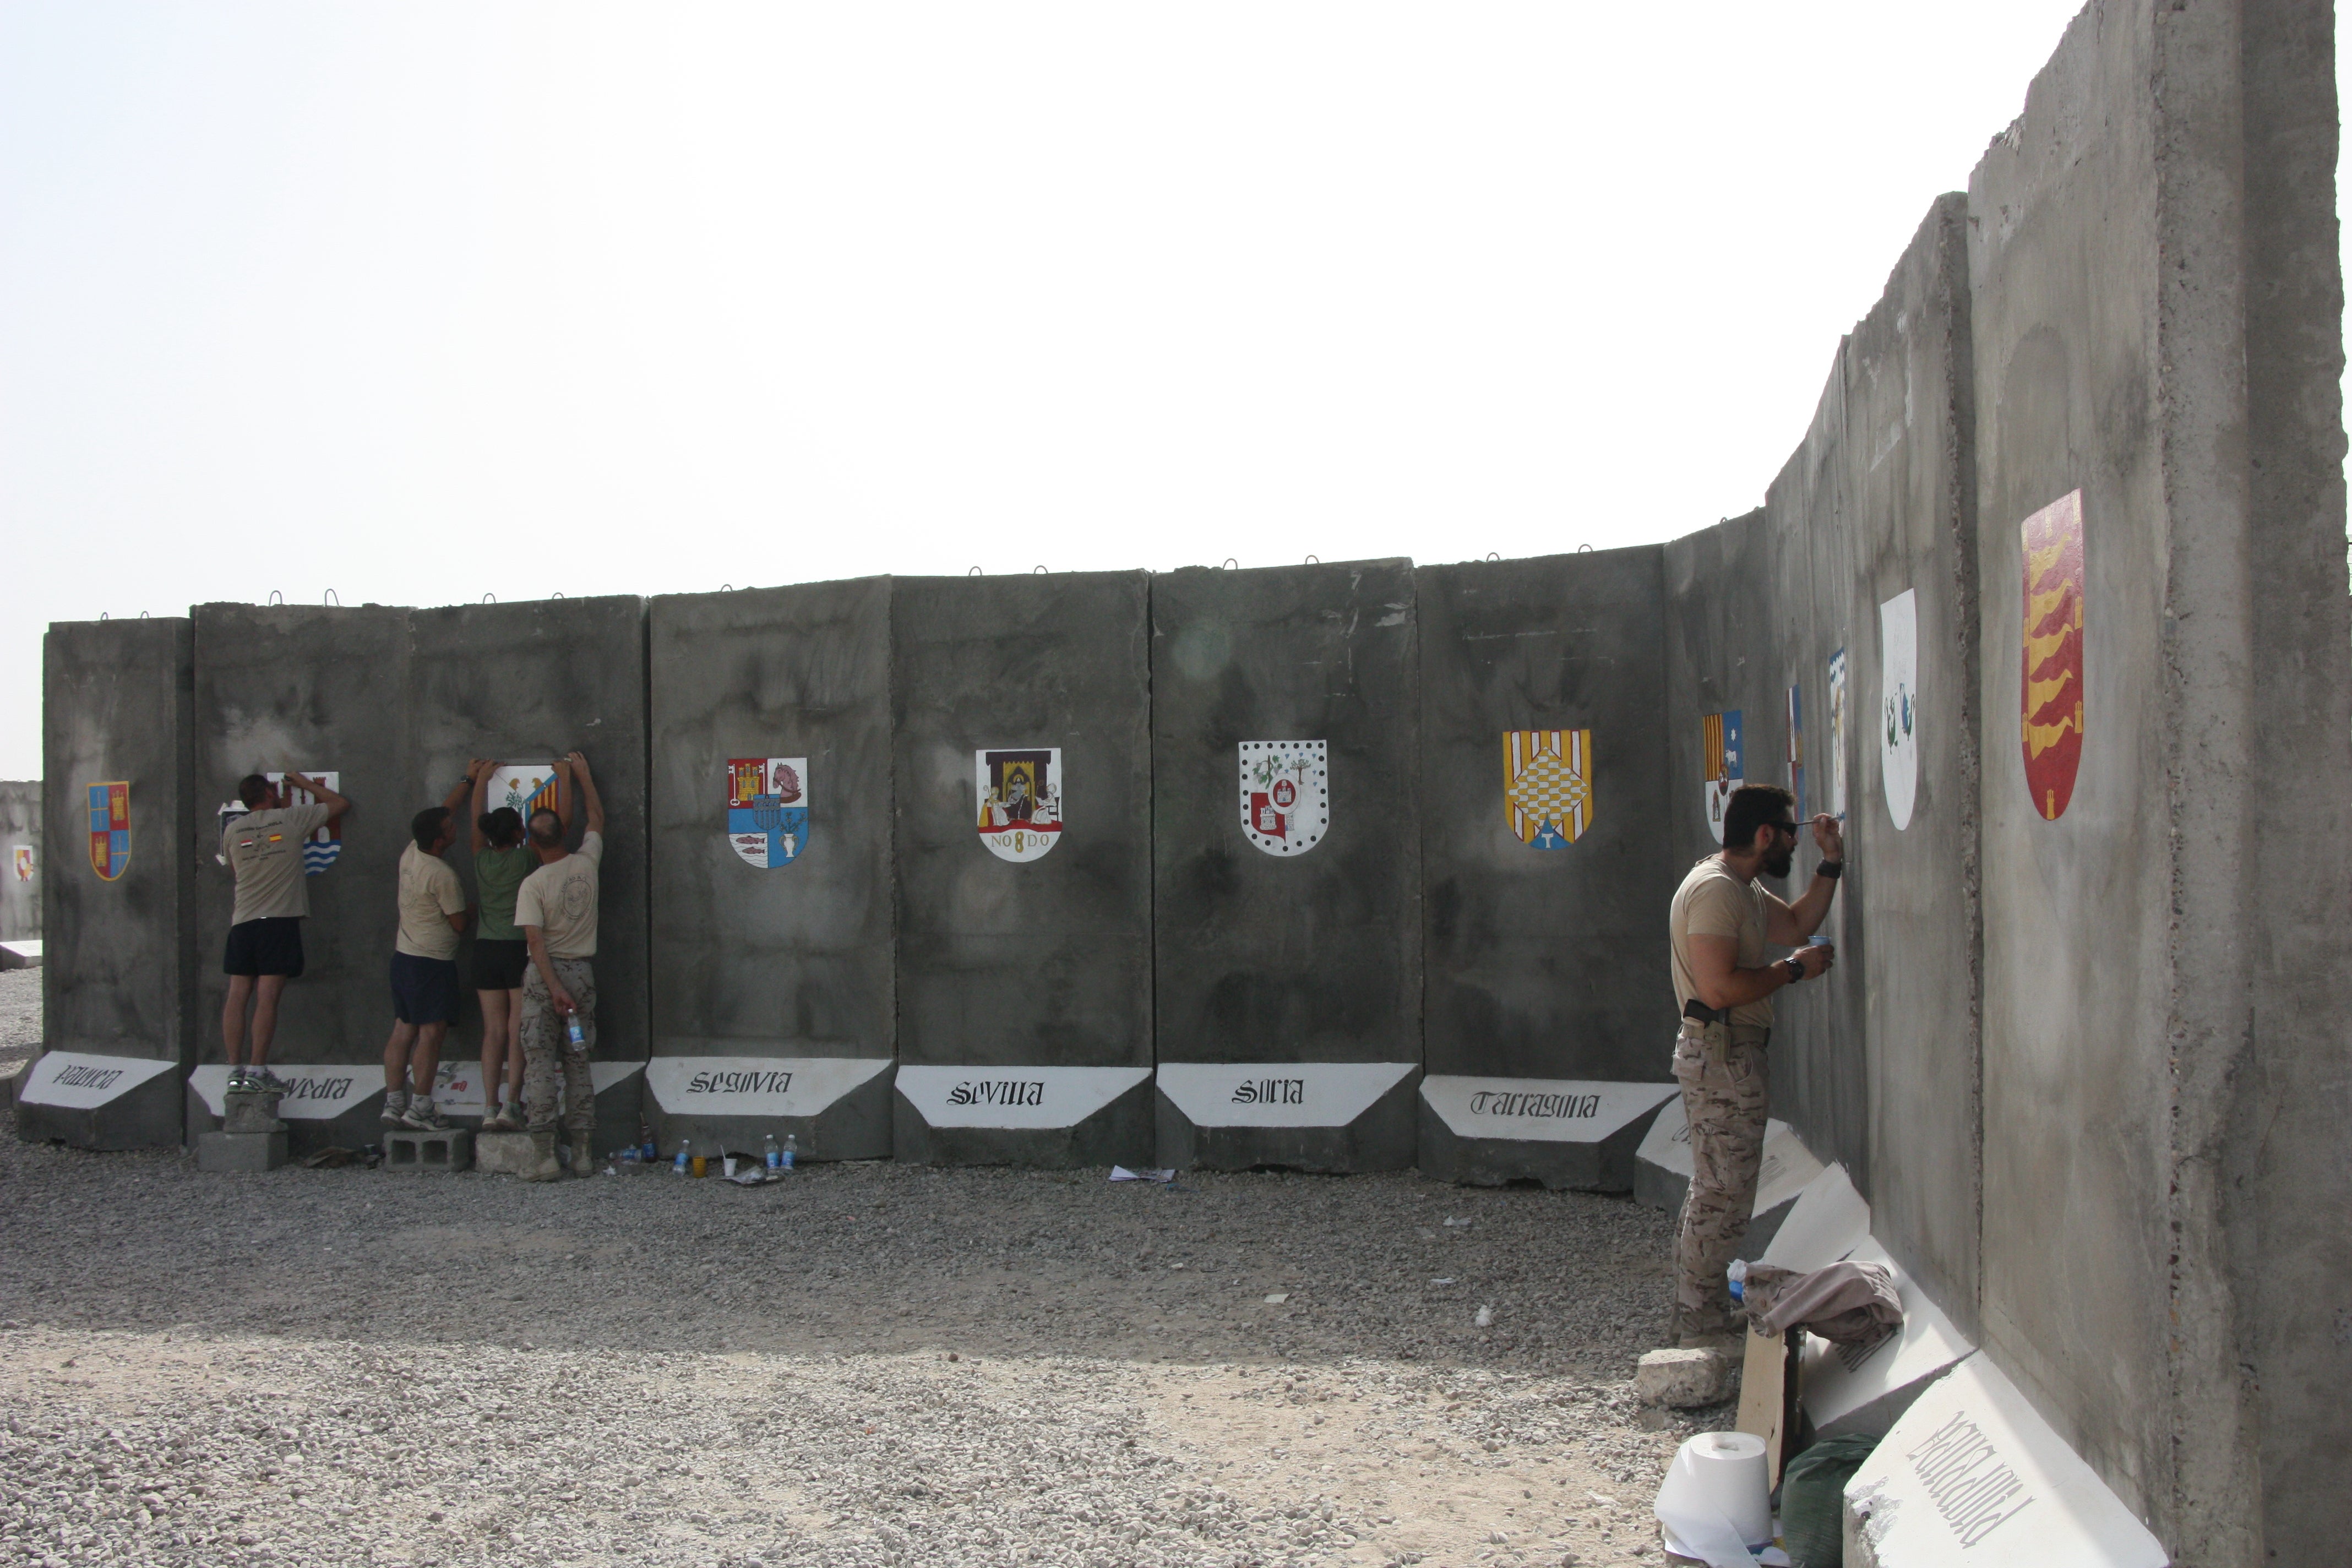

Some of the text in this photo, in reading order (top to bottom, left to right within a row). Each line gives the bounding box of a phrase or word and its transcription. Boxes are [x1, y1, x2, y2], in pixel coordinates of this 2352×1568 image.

[285, 1077, 354, 1099] vedra
[686, 1071, 794, 1094] Segovia
[946, 1081, 1046, 1106] Sevilla
[1231, 1079, 1304, 1104] Soria
[1470, 1091, 1601, 1118] Tarragona
[1905, 1410, 2038, 1550] Valladolid
